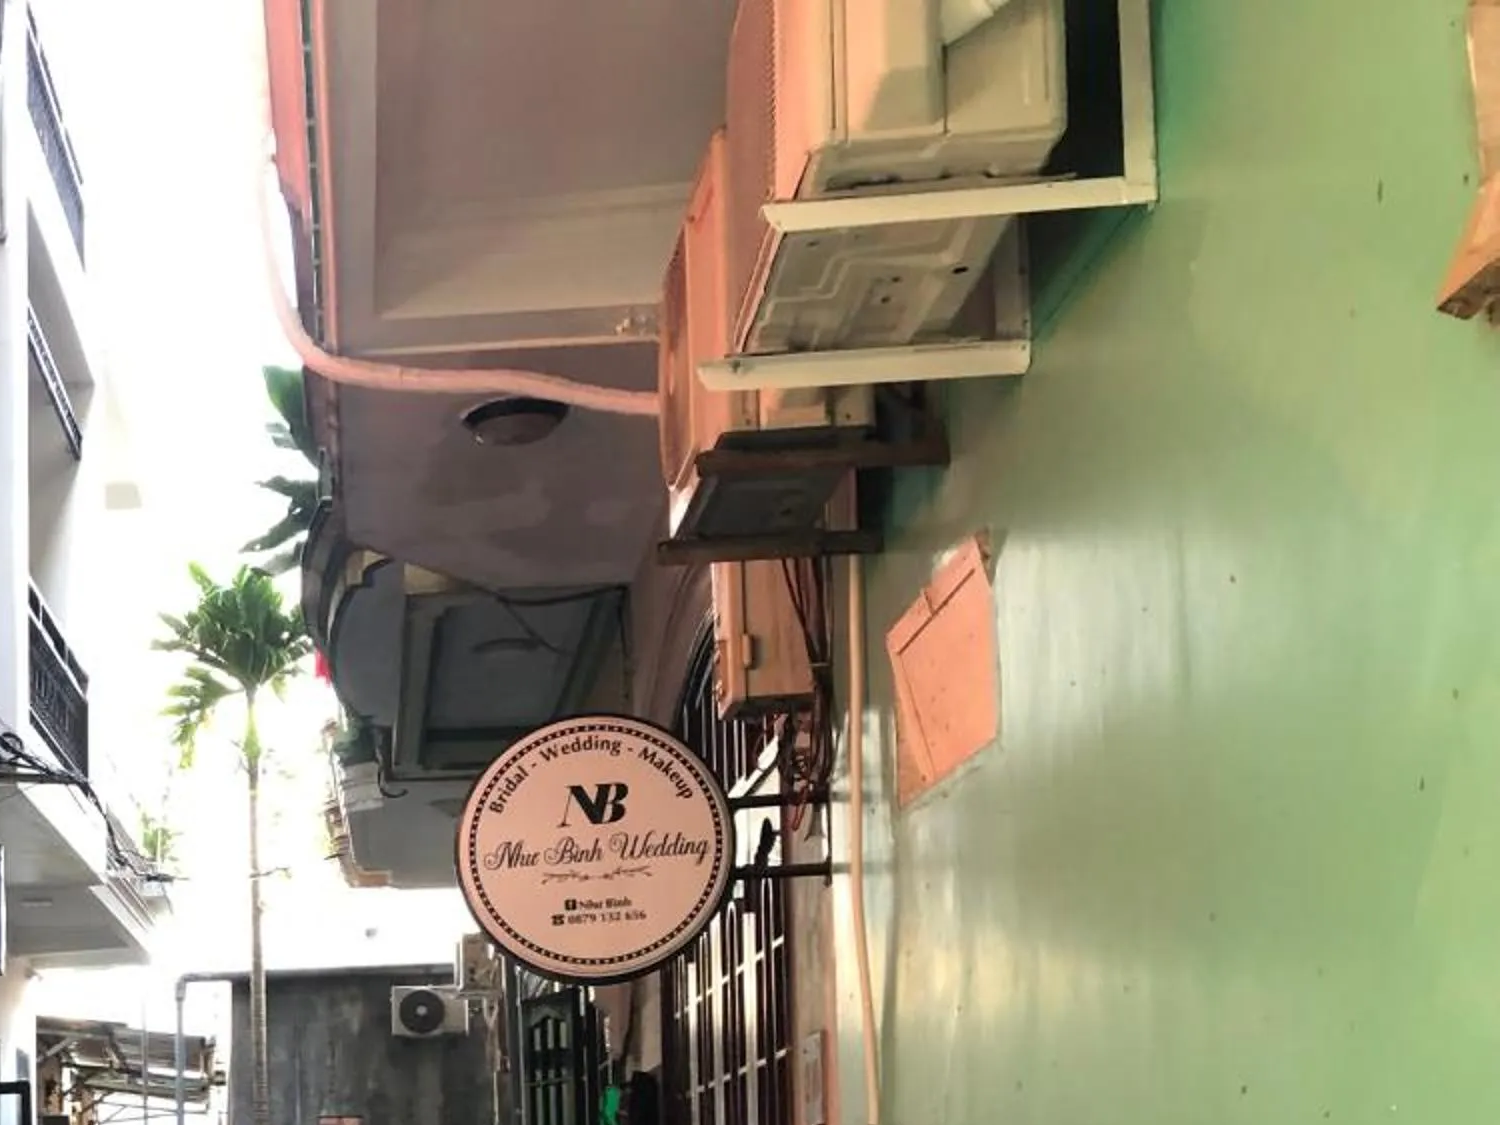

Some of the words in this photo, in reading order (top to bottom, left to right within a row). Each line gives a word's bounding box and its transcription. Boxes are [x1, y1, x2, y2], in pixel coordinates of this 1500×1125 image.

[489, 767, 528, 815] Bridal
[539, 735, 622, 763] Wedding
[637, 745, 695, 801] Makeup
[608, 829, 710, 866] Wedding
